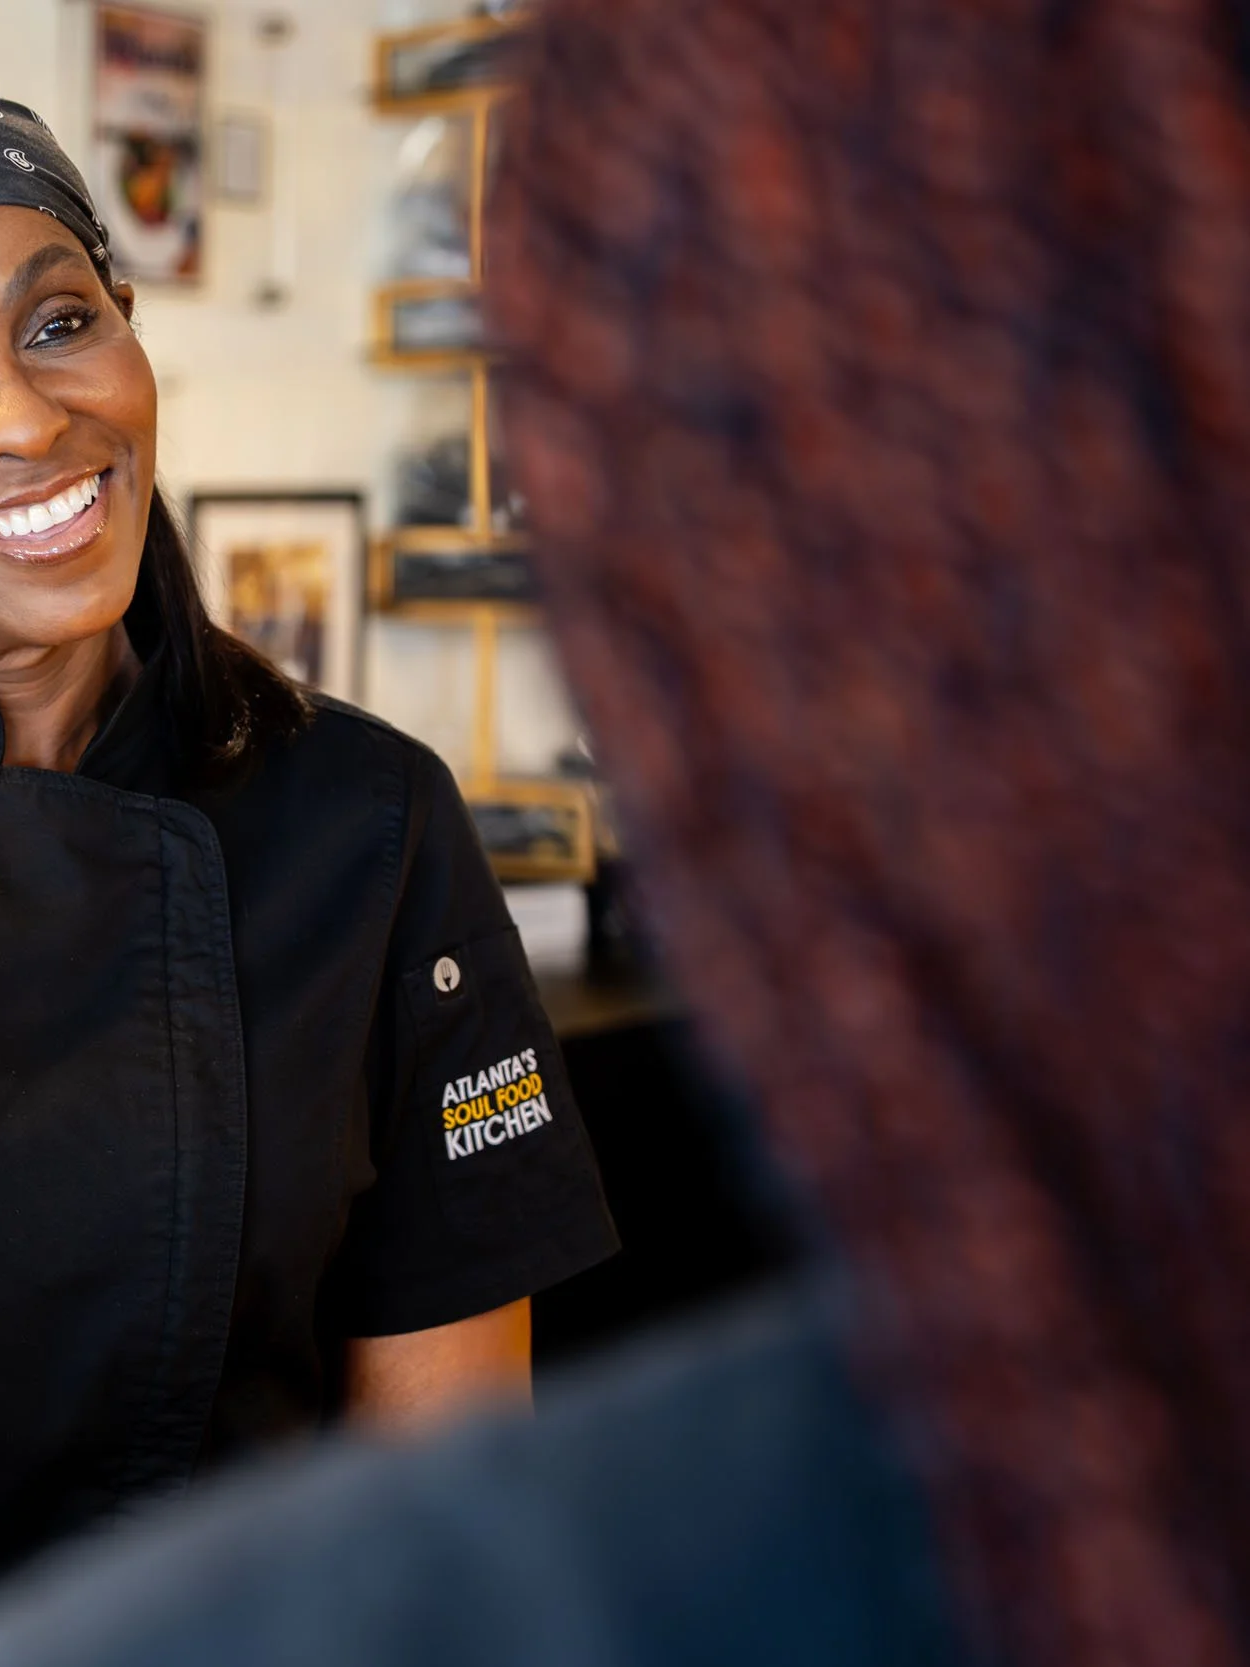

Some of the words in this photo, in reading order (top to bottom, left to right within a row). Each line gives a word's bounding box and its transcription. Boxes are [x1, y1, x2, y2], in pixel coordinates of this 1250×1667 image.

[442, 1048, 538, 1108] ATLANTA'S
[443, 1096, 496, 1129] SOUL
[496, 1072, 543, 1112] FOOD
[445, 1092, 553, 1160] KITCHEN
